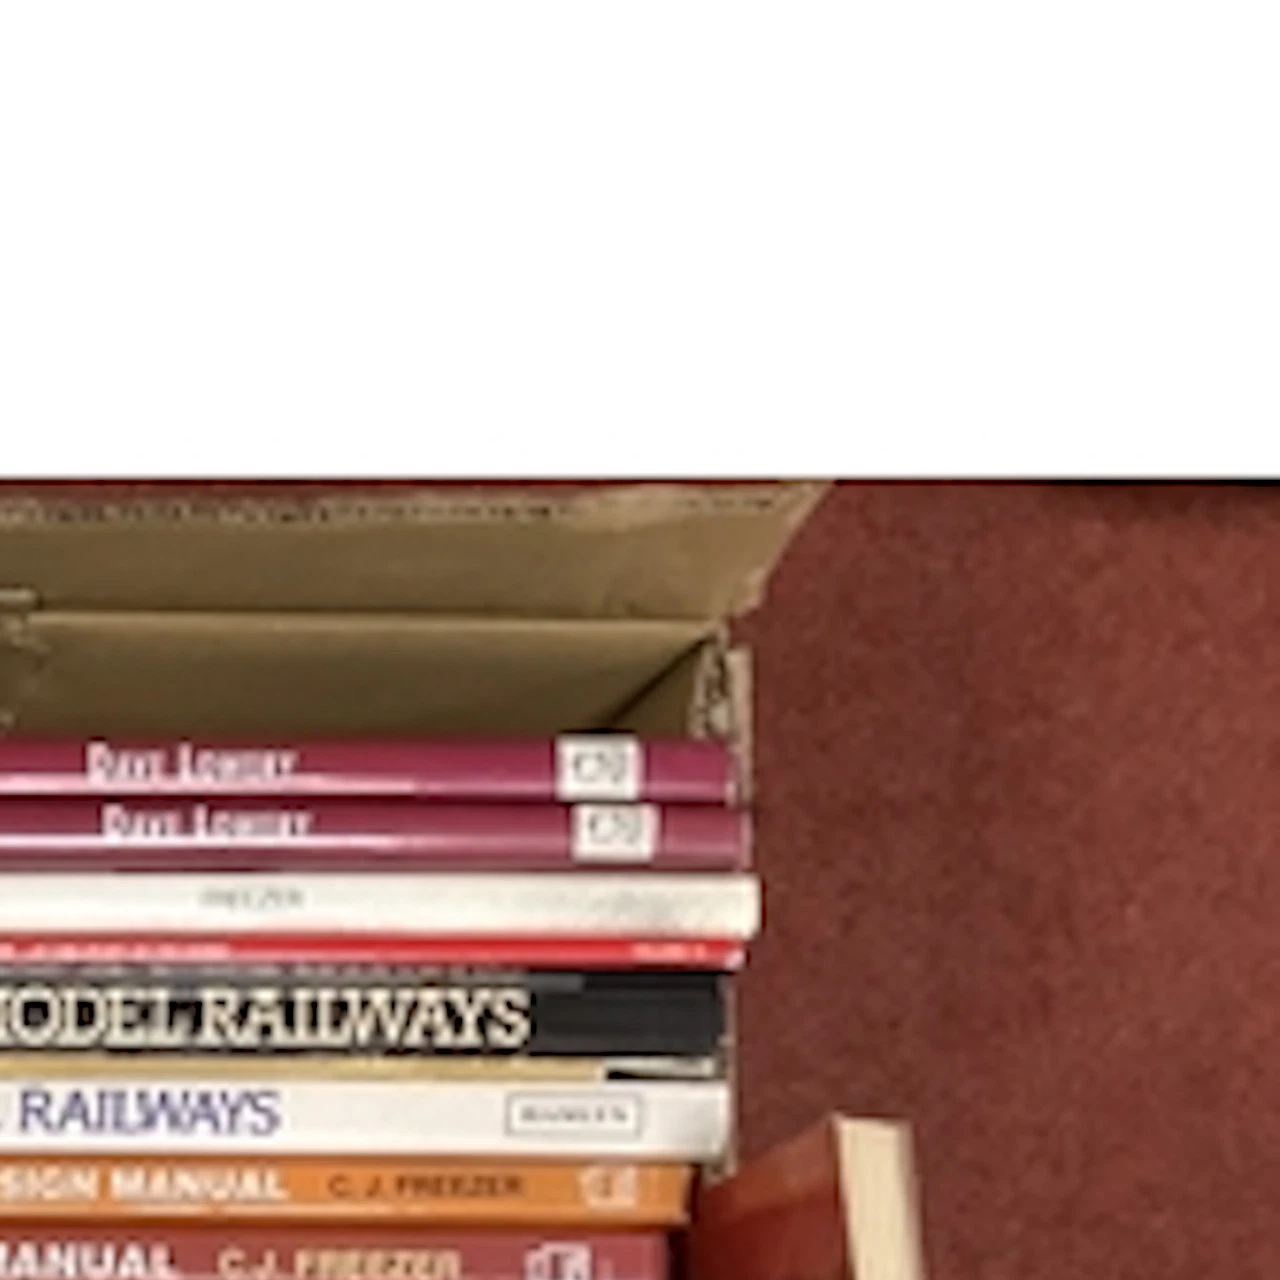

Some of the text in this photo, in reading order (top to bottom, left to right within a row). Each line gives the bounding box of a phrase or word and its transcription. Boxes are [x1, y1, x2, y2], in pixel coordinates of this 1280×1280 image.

[196, 987, 531, 1050] RAILWAYS
[18, 1088, 281, 1136] RAILWAYS
[110, 1168, 288, 1201] MANUAL
[395, 1176, 524, 1197] FREEZER
